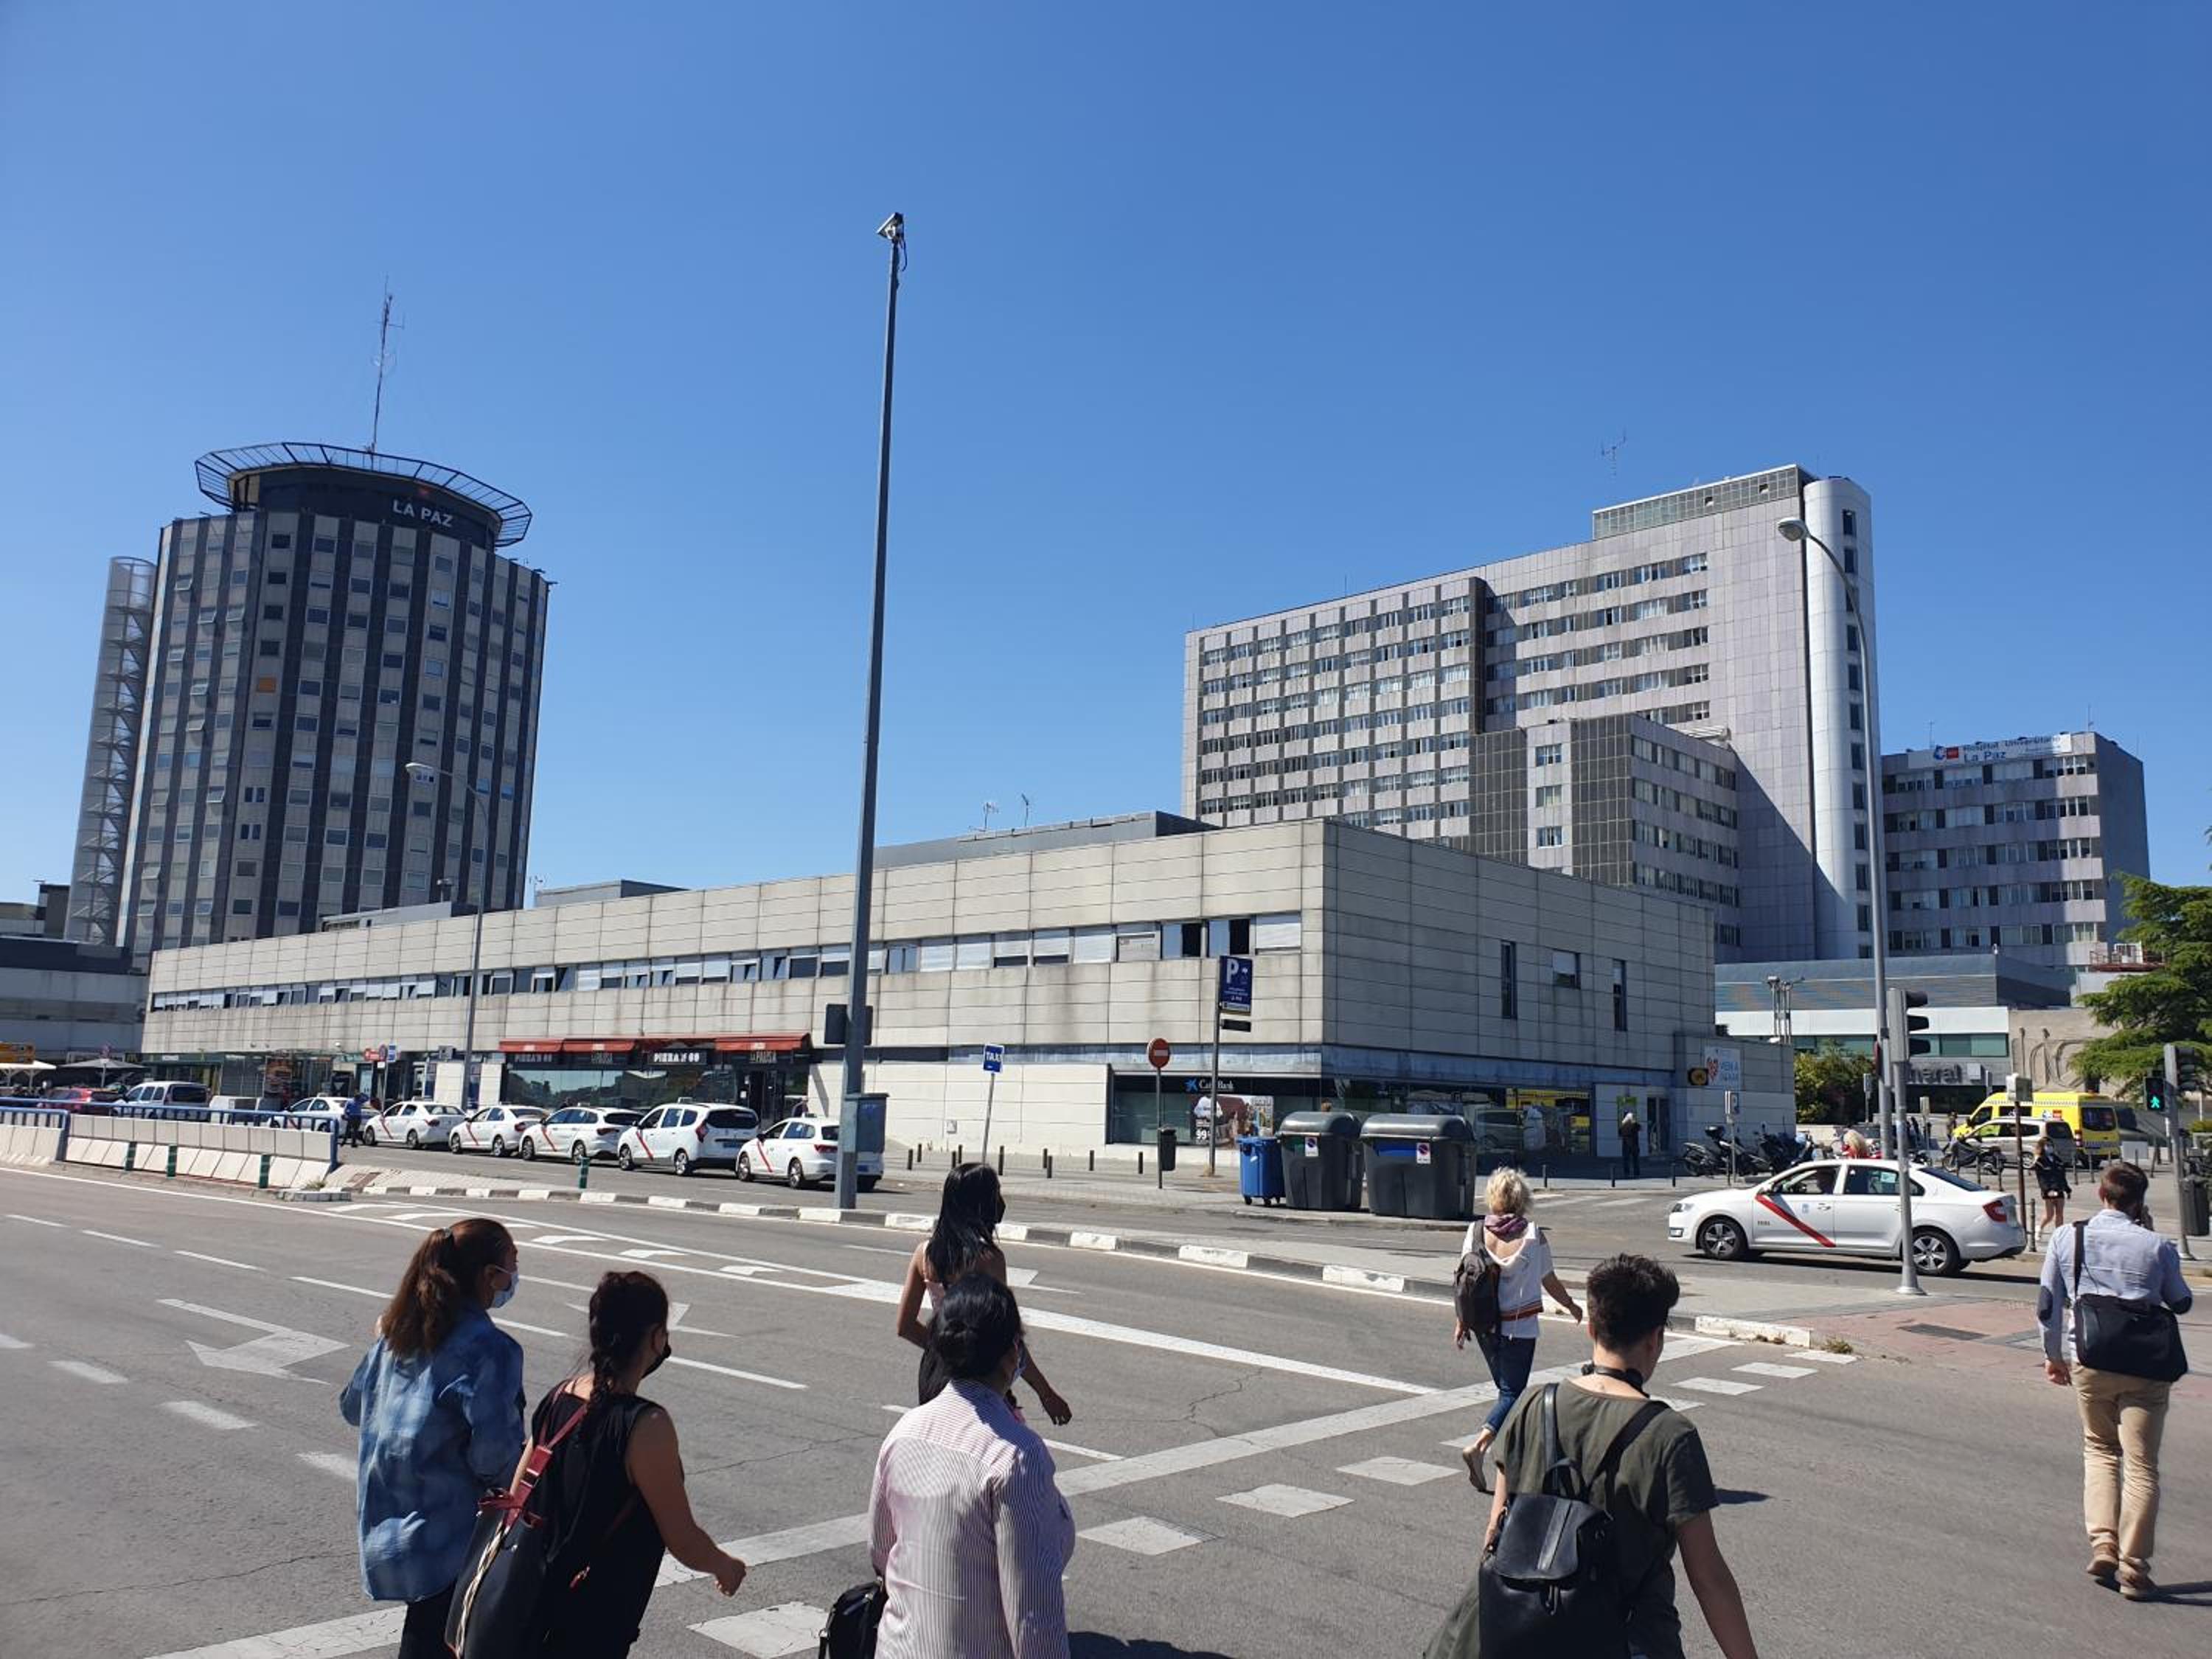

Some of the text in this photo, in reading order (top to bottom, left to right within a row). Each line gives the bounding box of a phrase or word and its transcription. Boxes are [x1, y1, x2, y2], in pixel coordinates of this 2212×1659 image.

[393, 499, 453, 527] LA PAZ
[1964, 751, 2006, 762] La Paz
[1226, 958, 1239, 984] P
